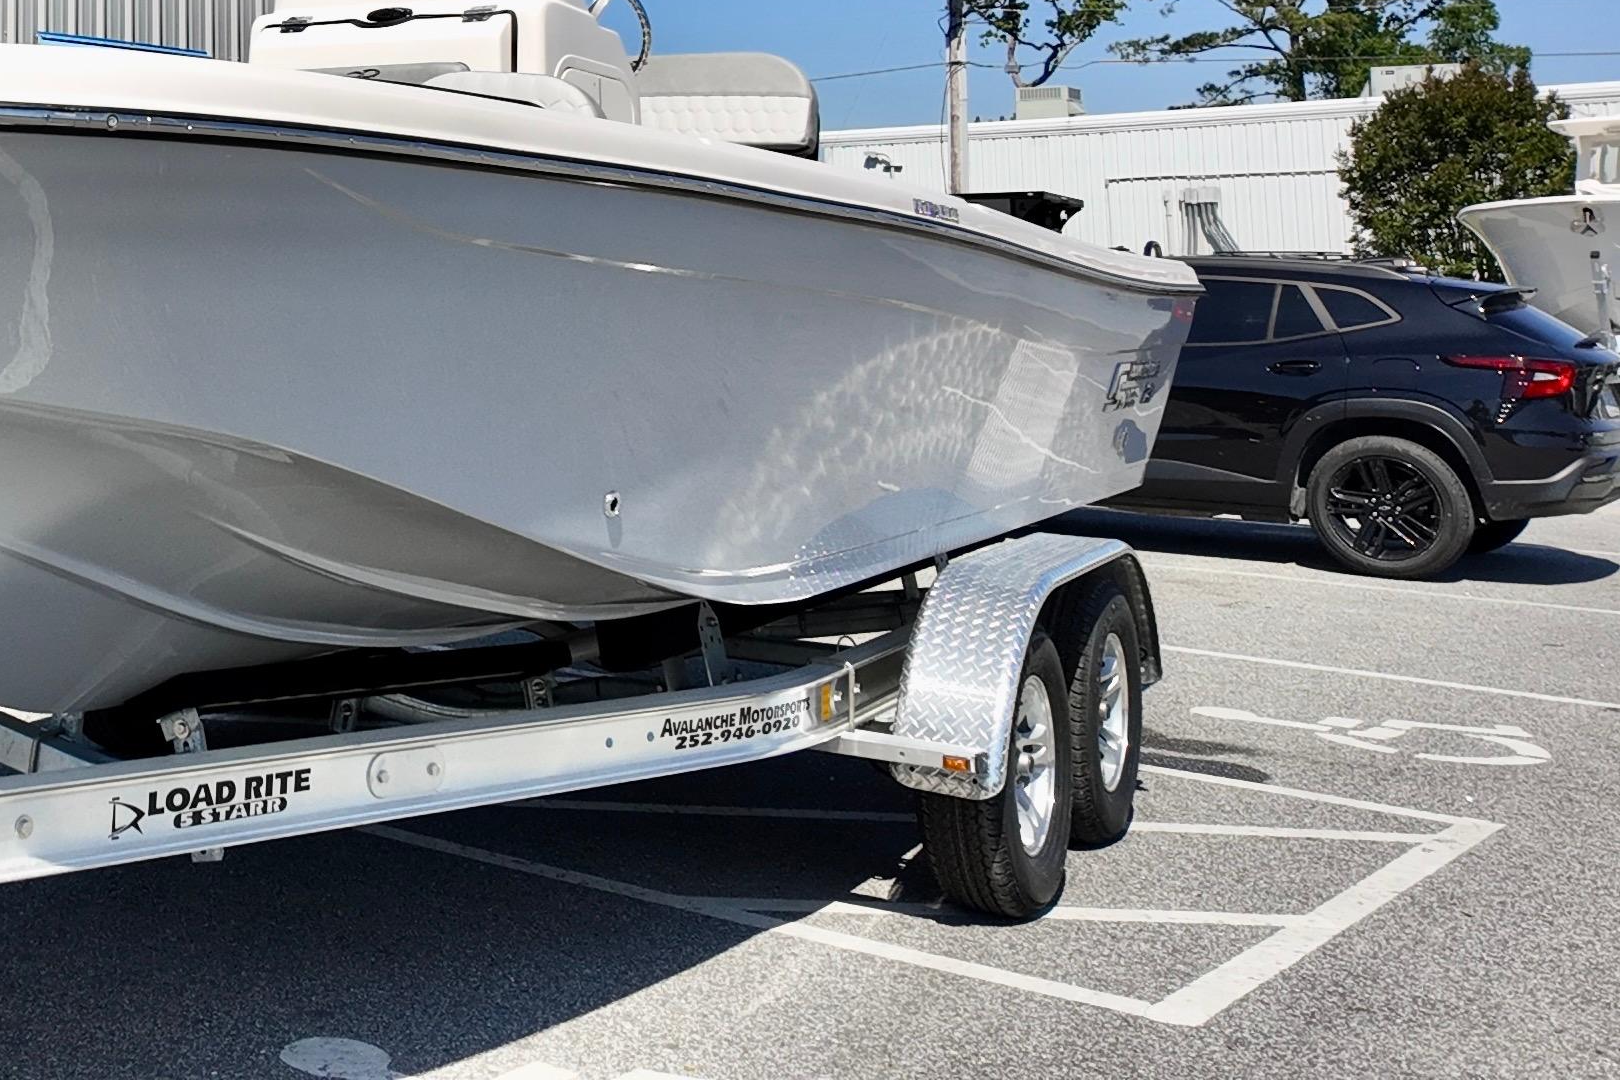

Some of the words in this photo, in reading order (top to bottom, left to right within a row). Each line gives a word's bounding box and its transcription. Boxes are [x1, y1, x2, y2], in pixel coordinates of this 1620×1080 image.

[660, 713, 736, 738] AVALANCHE
[739, 697, 810, 726] MOTORSPORTS
[675, 715, 800, 750] 252-946-0920
[148, 780, 237, 816] LOAD
[244, 768, 311, 800] RITE
[180, 812, 193, 828] 5
[200, 797, 282, 824] STARR
